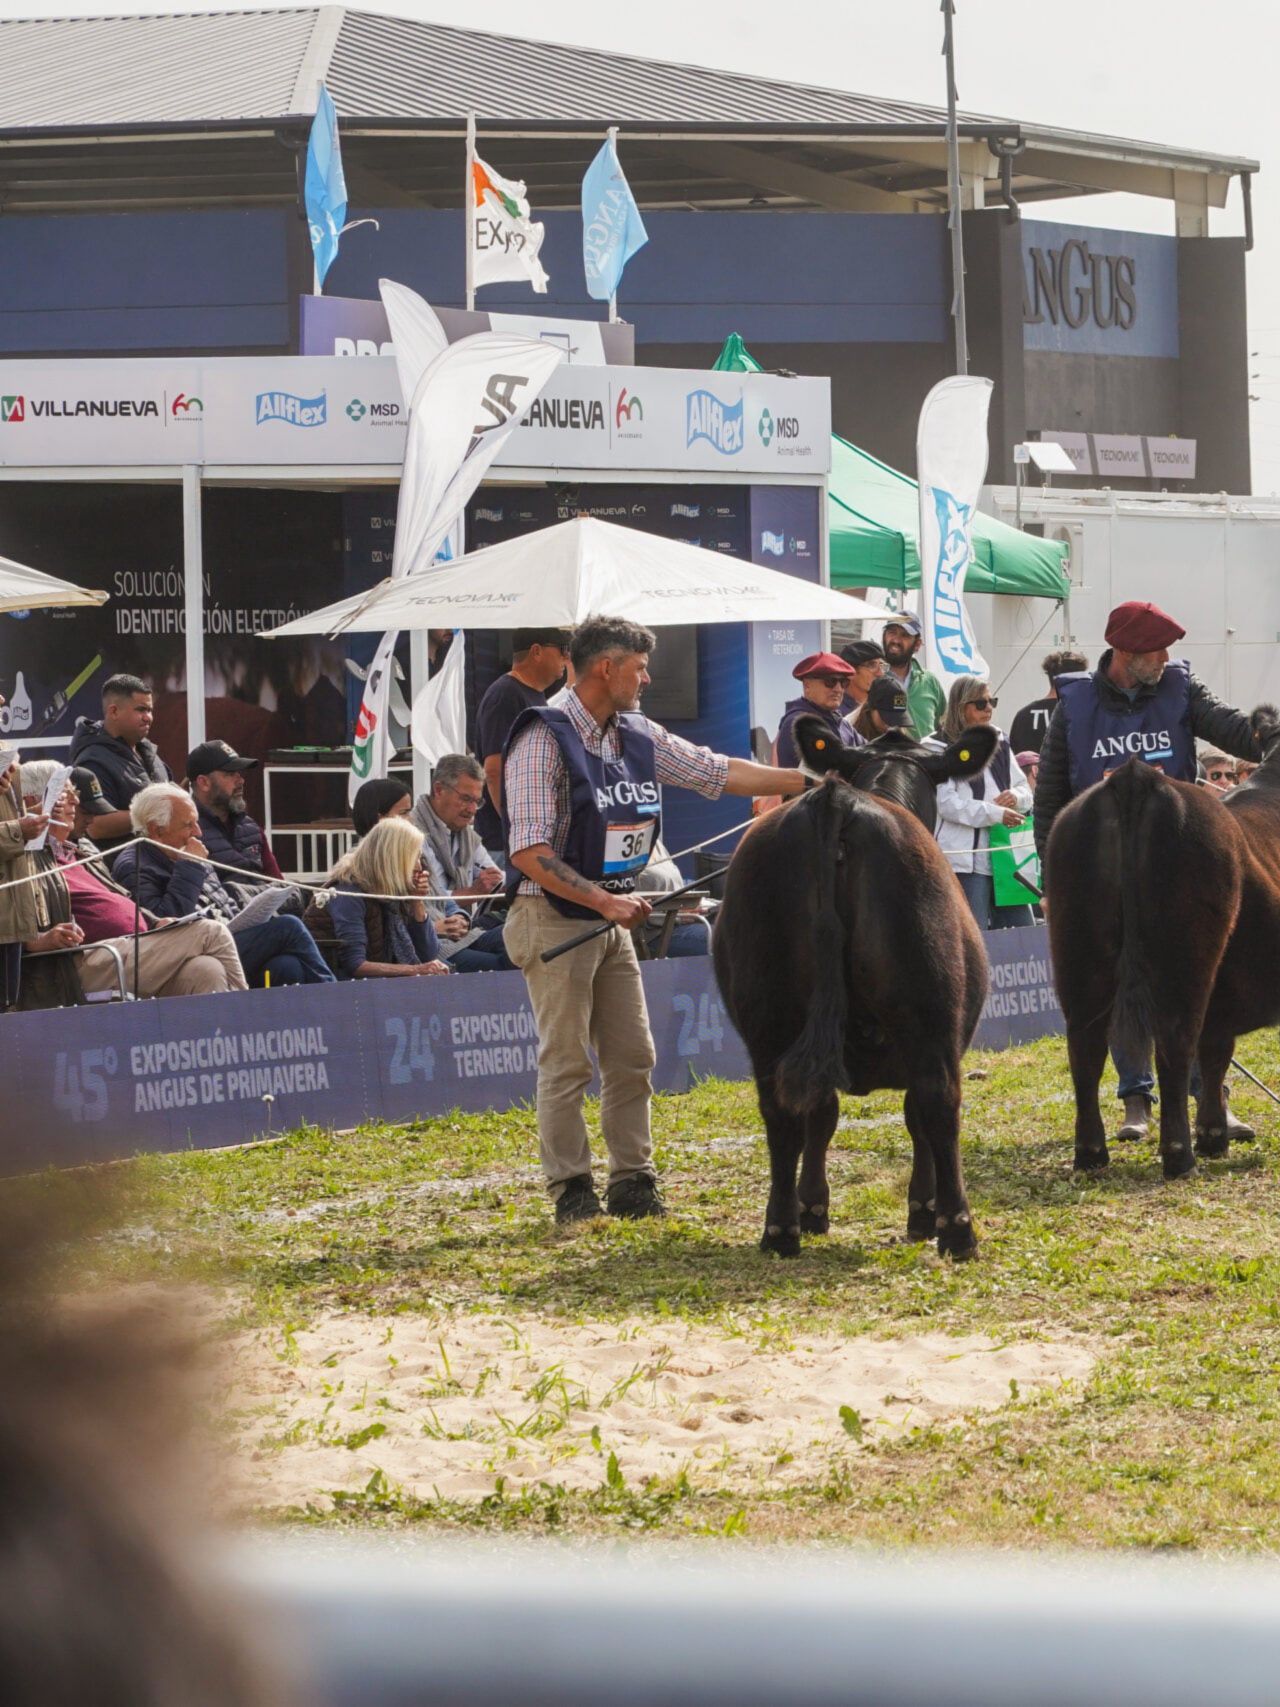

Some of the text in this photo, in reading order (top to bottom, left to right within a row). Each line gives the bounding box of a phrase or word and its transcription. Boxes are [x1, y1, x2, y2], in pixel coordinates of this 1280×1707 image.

[31, 400, 159, 417] VILLANUEVA
[258, 392, 326, 426] Allflex
[370, 404, 400, 416] MSD
[520, 398, 604, 430] ANUEVA
[688, 393, 743, 453] Allflex
[777, 417, 799, 438] MSD
[114, 563, 186, 597] SOLUCIÓN
[116, 602, 232, 634] IDENTIFICIÓN
[1092, 730, 1172, 759] ANGUS
[621, 832, 644, 858] 36
[987, 954, 1047, 988] POSICIÓN
[980, 991, 1019, 1019] NGUS
[1020, 989, 1038, 1014] DE
[451, 1004, 540, 1045] EXPOSICIÓN
[130, 1027, 328, 1076] EXPOSICIÓN NACIONAL
[134, 1041, 330, 1093] ANGUS DE PRIMAVERA
[453, 1046, 523, 1078] TERNERO
